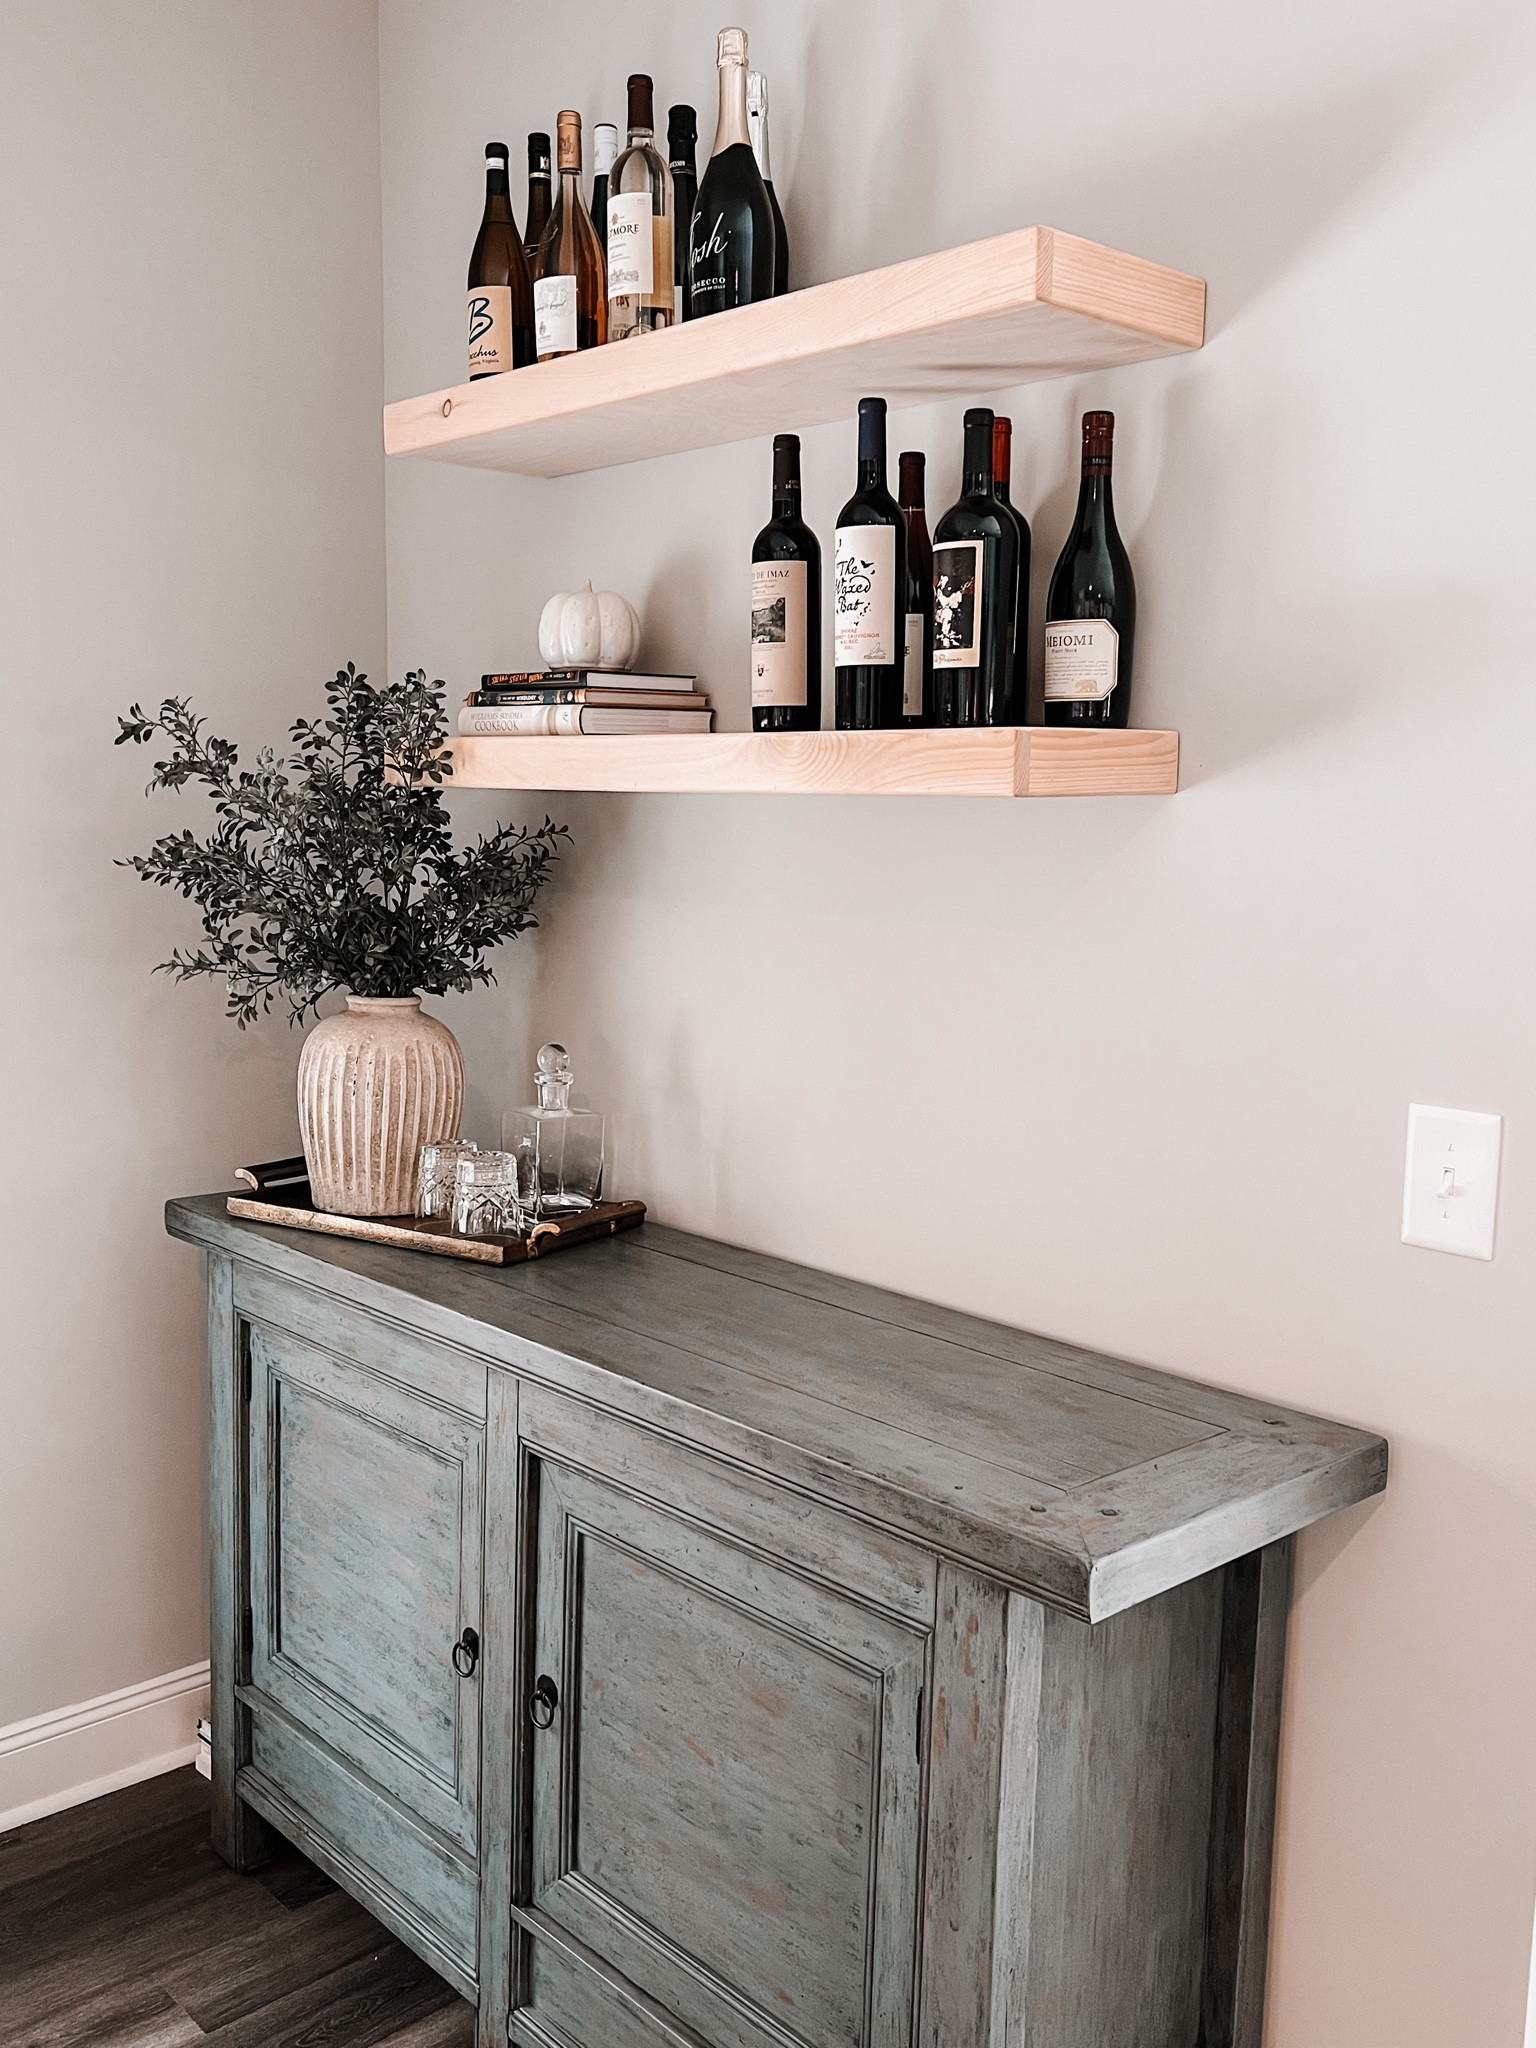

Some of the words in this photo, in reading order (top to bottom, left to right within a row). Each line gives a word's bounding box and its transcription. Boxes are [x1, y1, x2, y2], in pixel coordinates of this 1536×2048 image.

[608, 224, 640, 240] TMORE
[468, 297, 494, 346] B
[469, 344, 499, 360] cchus
[767, 570, 790, 578] IMAZ
[836, 556, 860, 576] The
[838, 596, 865, 613] Bat
[1046, 634, 1094, 648] MEIOMI
[475, 720, 519, 732] COOKBOOK
